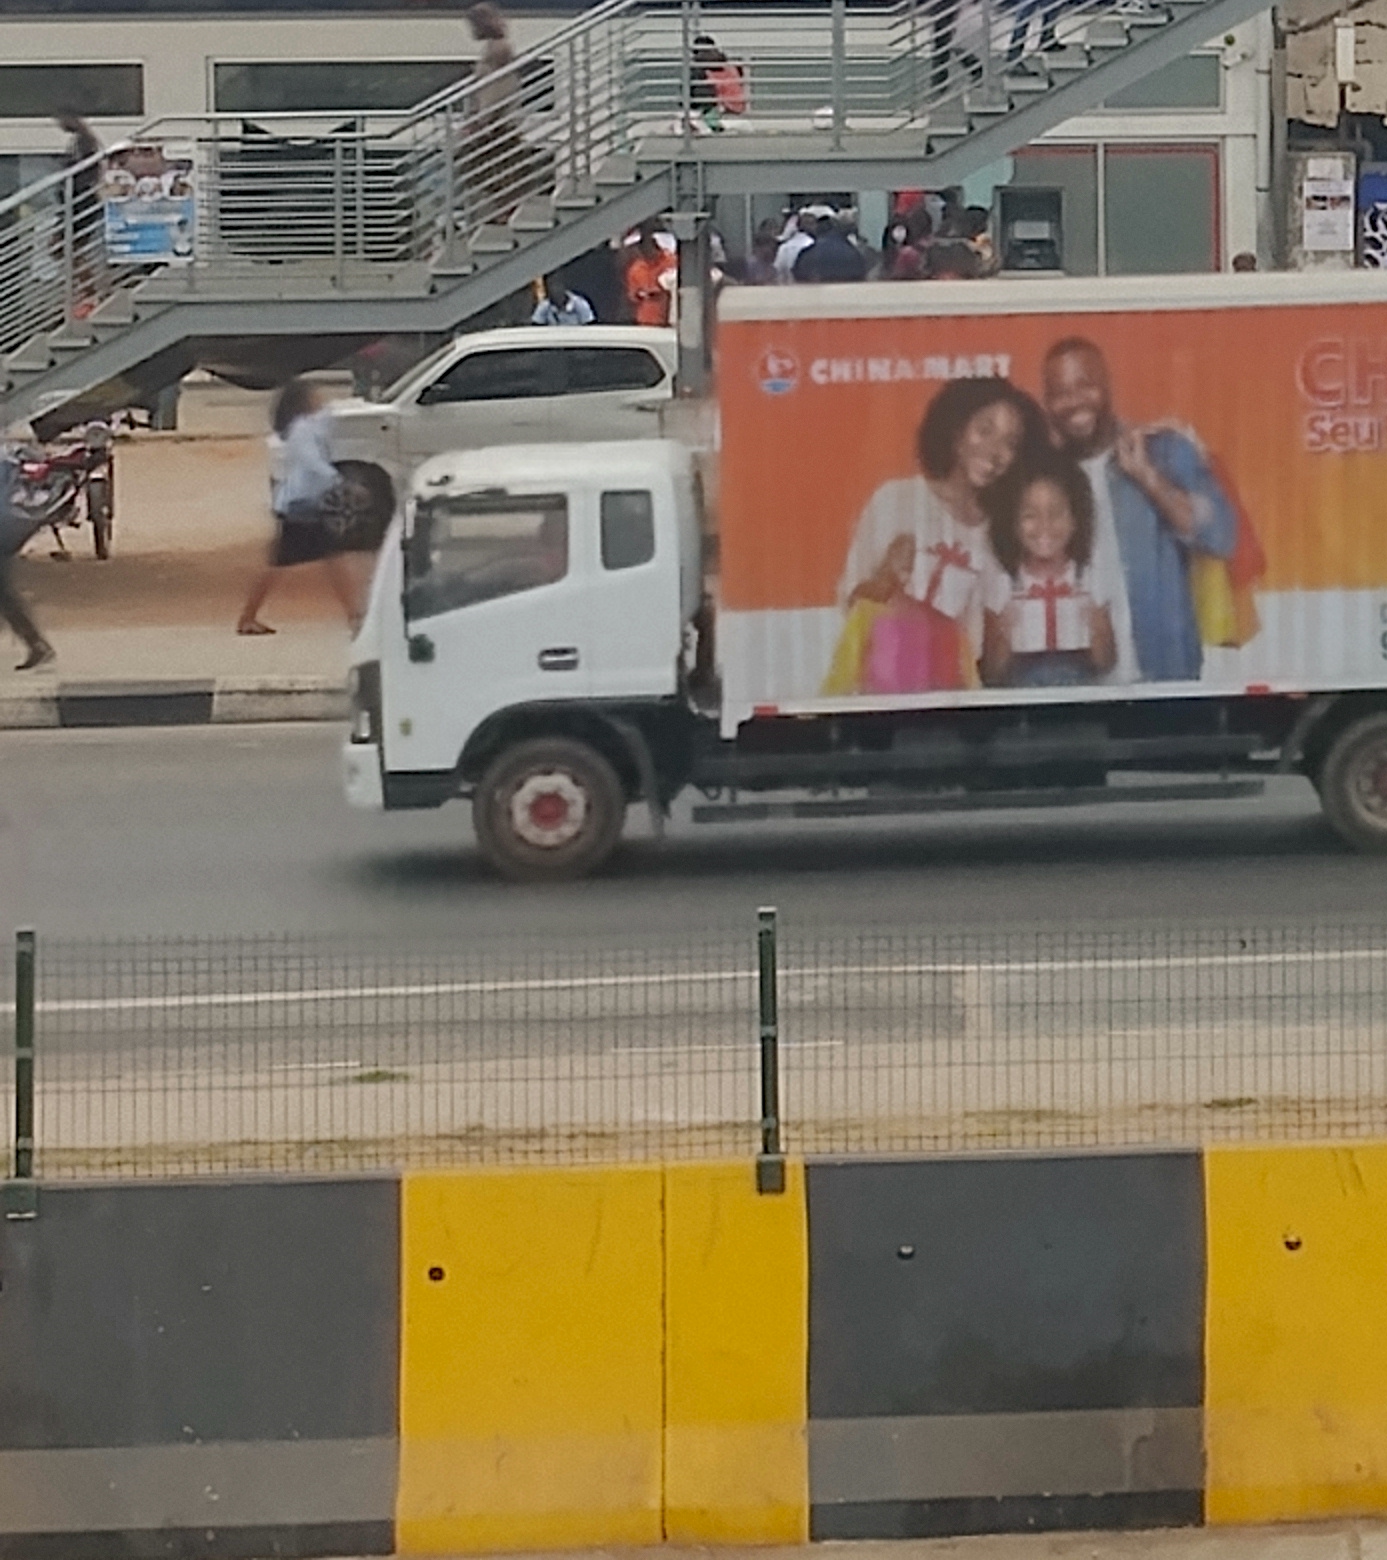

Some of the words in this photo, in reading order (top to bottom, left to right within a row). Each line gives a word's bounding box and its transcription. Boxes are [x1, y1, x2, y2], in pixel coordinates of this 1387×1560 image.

[809, 357, 916, 385] CHINA
[923, 353, 1012, 380] MART
[1305, 411, 1379, 452] Seu
